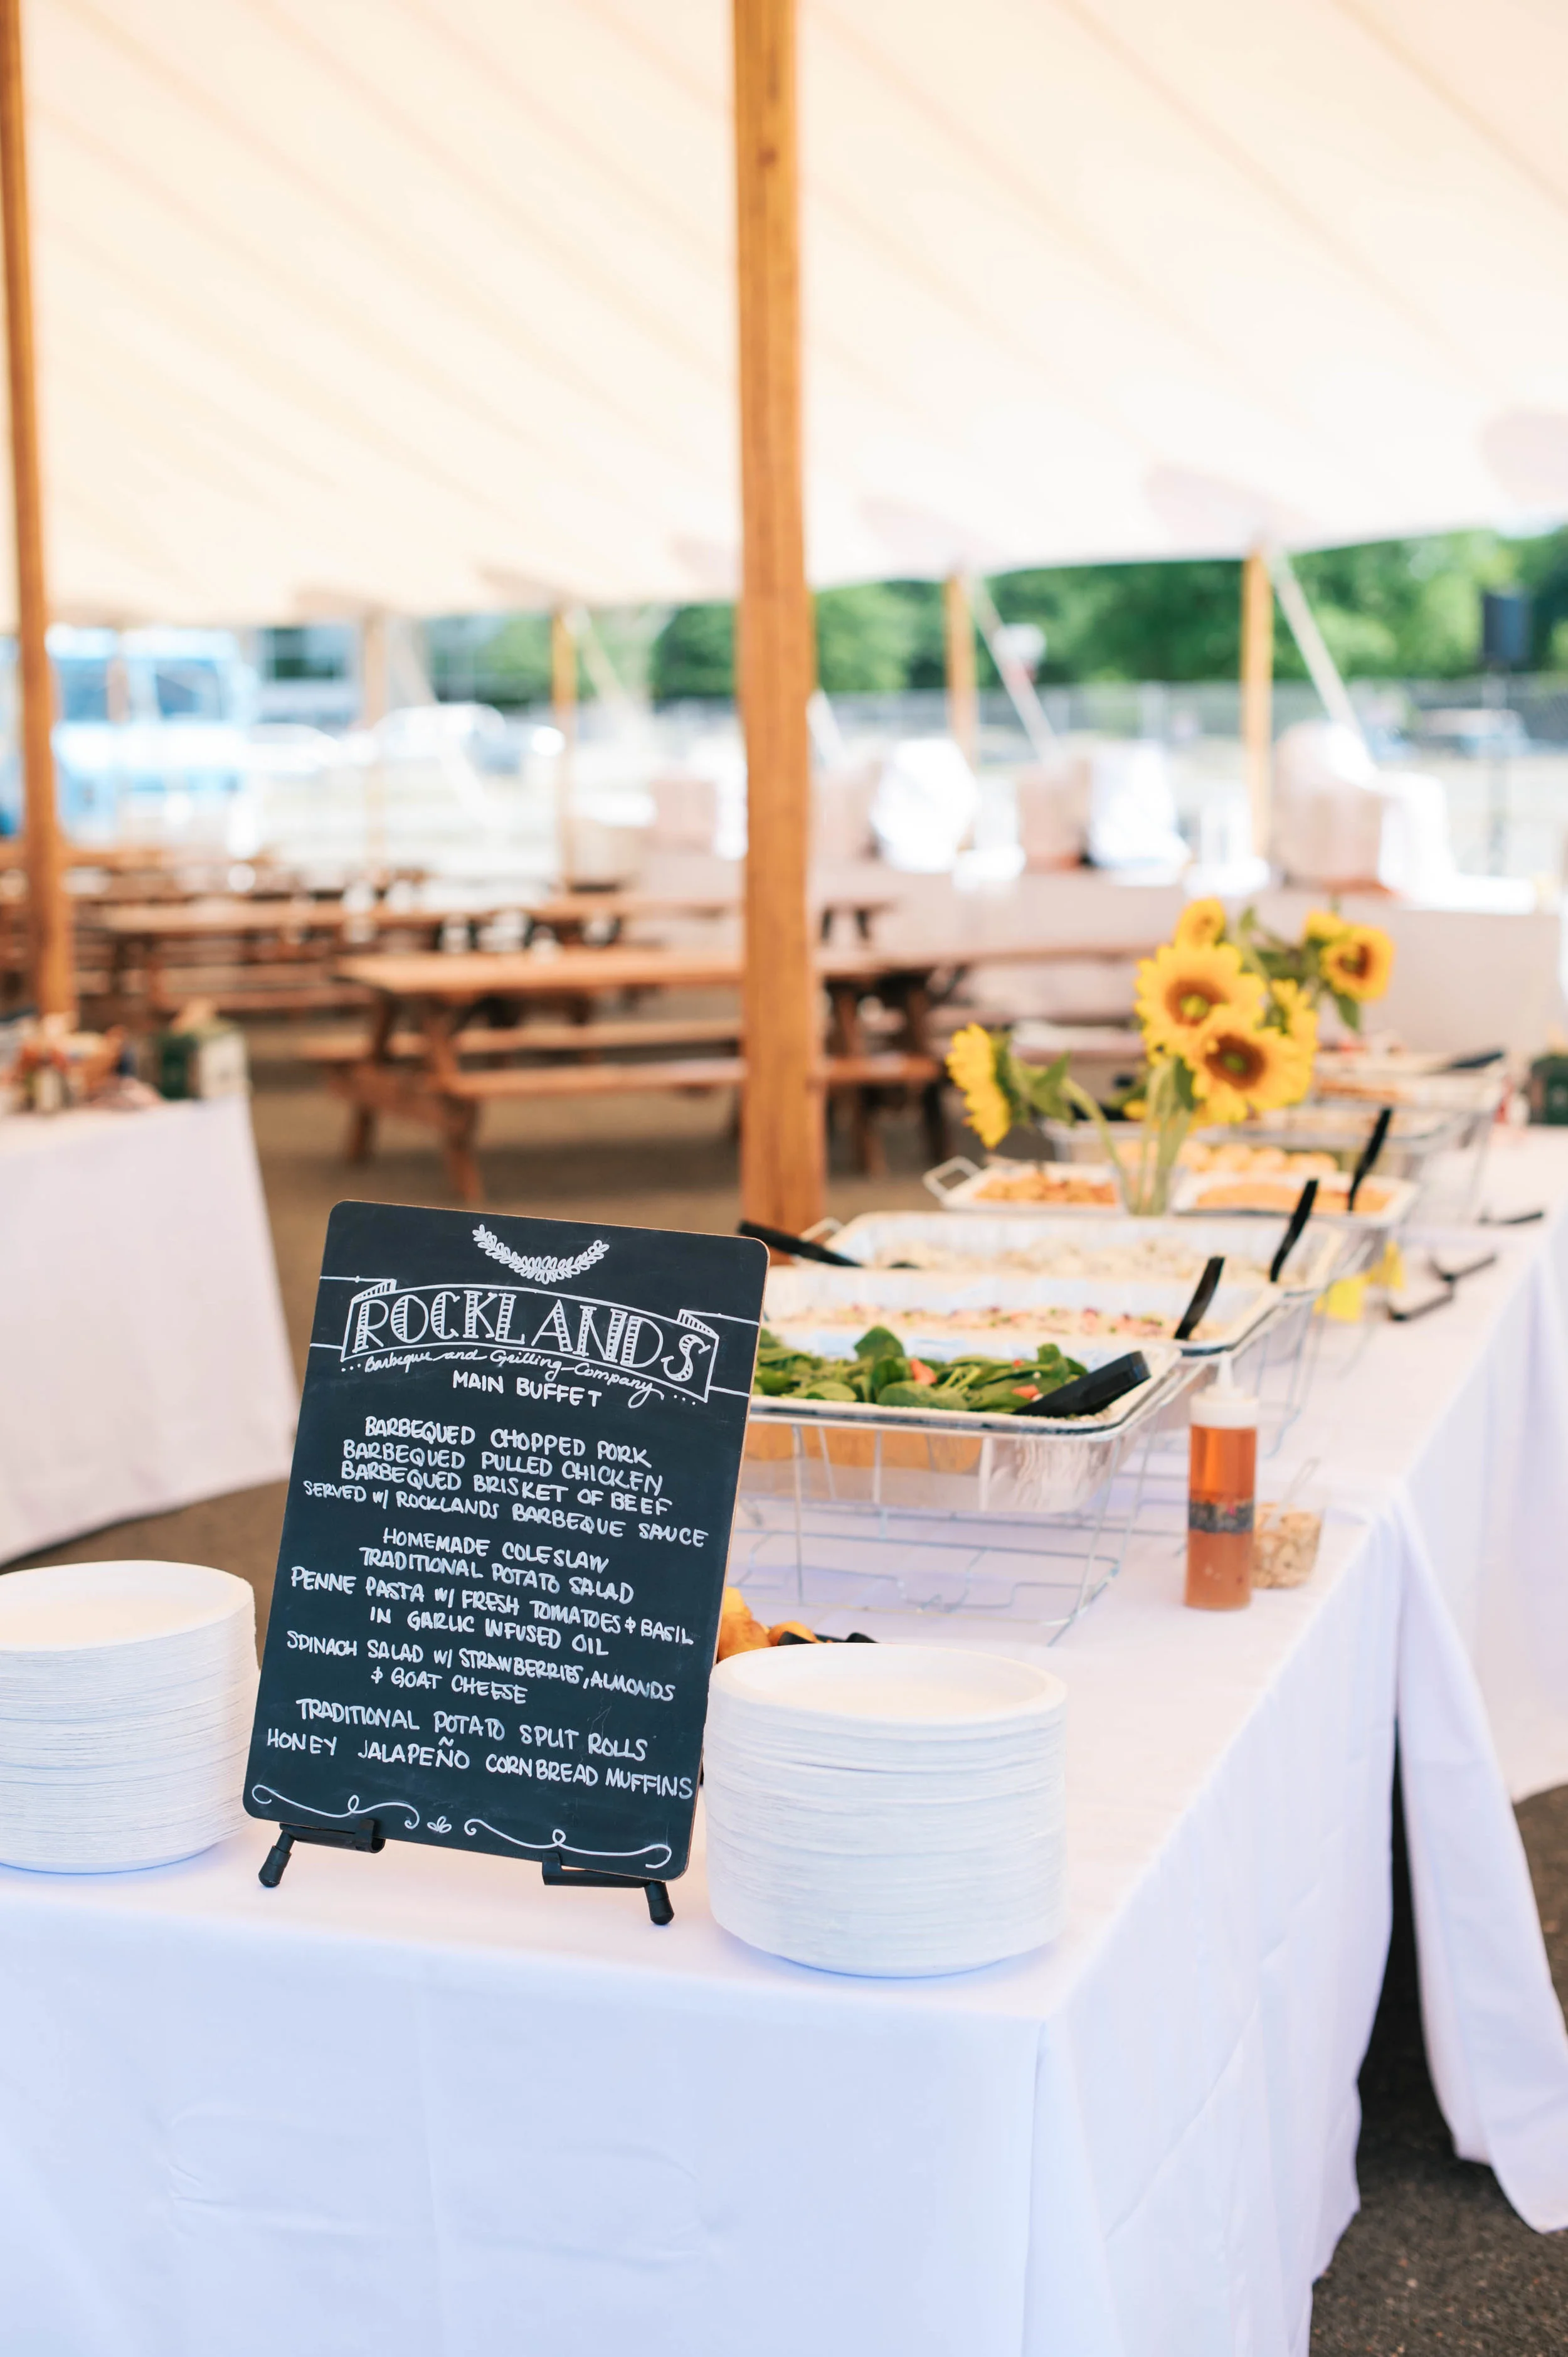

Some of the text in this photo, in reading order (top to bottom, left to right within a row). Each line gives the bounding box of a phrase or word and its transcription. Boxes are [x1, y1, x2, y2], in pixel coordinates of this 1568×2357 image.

[352, 1290, 711, 1382] ROCKLANDS
[365, 1349, 664, 1409] Barbeque and Grilling Company
[453, 1370, 602, 1407] MAIN BUFFET
[344, 1439, 662, 1496] BARBEQUED PULLED CHICKEN
[365, 1416, 652, 1468] BARBEQUED CHOPPED PORK
[303, 1481, 366, 1503] SERVED
[396, 1491, 499, 1519] ROCKLANDS
[512, 1503, 626, 1537] BARBEQUE
[638, 1523, 709, 1547] SAUCE
[341, 1460, 672, 1515] BARBEQUED BRISKET OF BEEF
[359, 1547, 633, 1604] TRADITIONAL POTATO SALAD
[383, 1528, 609, 1573] HOMEMADE COLESLAW
[291, 1566, 356, 1594] PENNE
[366, 1577, 425, 1602] PASTA
[462, 1590, 519, 1615] FRESH
[529, 1600, 620, 1634] TOMATOES
[641, 1619, 694, 1645] BASIL
[370, 1607, 608, 1656] IN GARLIC INFUSED OIL
[368, 1639, 423, 1663] SALAD
[391, 1667, 442, 1689] GOAT
[452, 1675, 527, 1704] CHEESE
[296, 1698, 647, 1761] TRADITIONAL POTATO SPLIT ROLLS
[267, 1728, 337, 1755] HONEY
[358, 1737, 470, 1769] JALAPEÑO
[605, 1768, 693, 1799] MUFFINS
